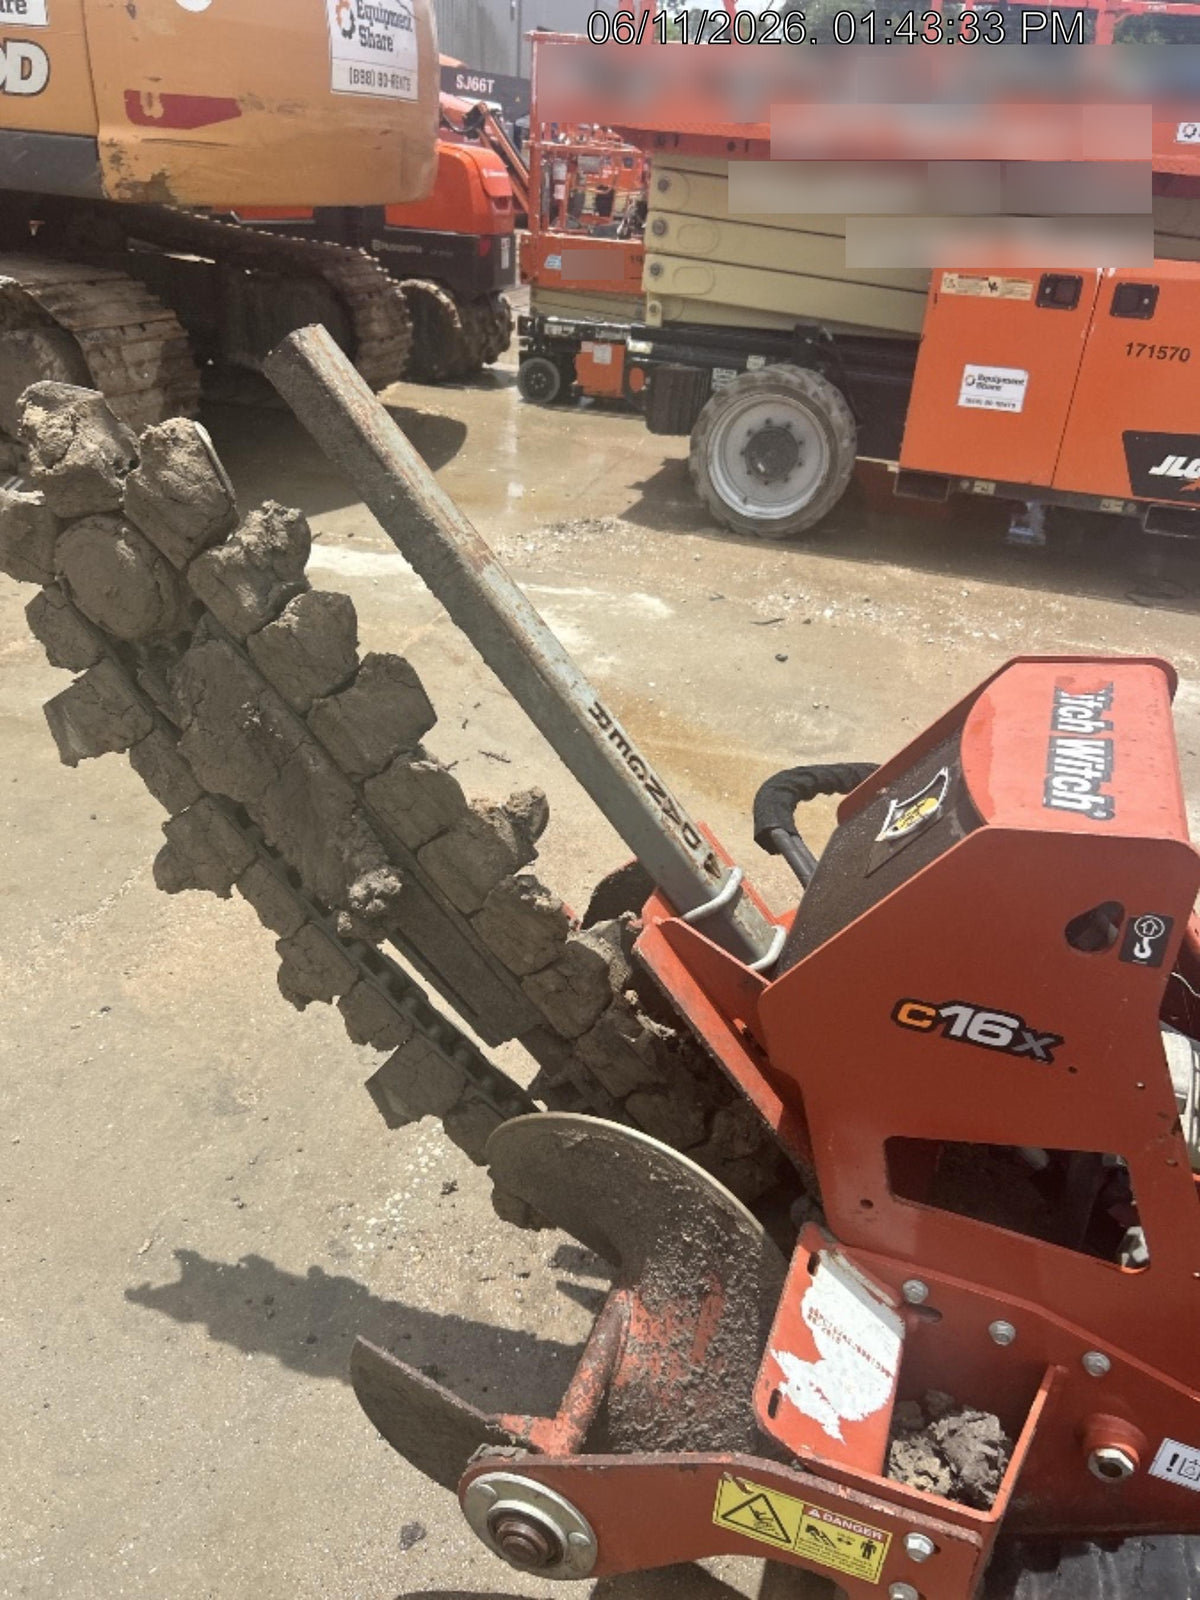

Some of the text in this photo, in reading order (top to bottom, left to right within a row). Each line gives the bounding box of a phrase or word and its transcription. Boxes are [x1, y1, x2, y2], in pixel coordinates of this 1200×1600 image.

[358, 25, 395, 52] Share
[0, 37, 51, 97] D
[456, 74, 495, 93] SJ66T
[1126, 342, 1191, 363] 171570
[1048, 686, 1110, 813] itch Witch
[588, 700, 702, 851] DANGER
[822, 1512, 883, 1541] DANGER
